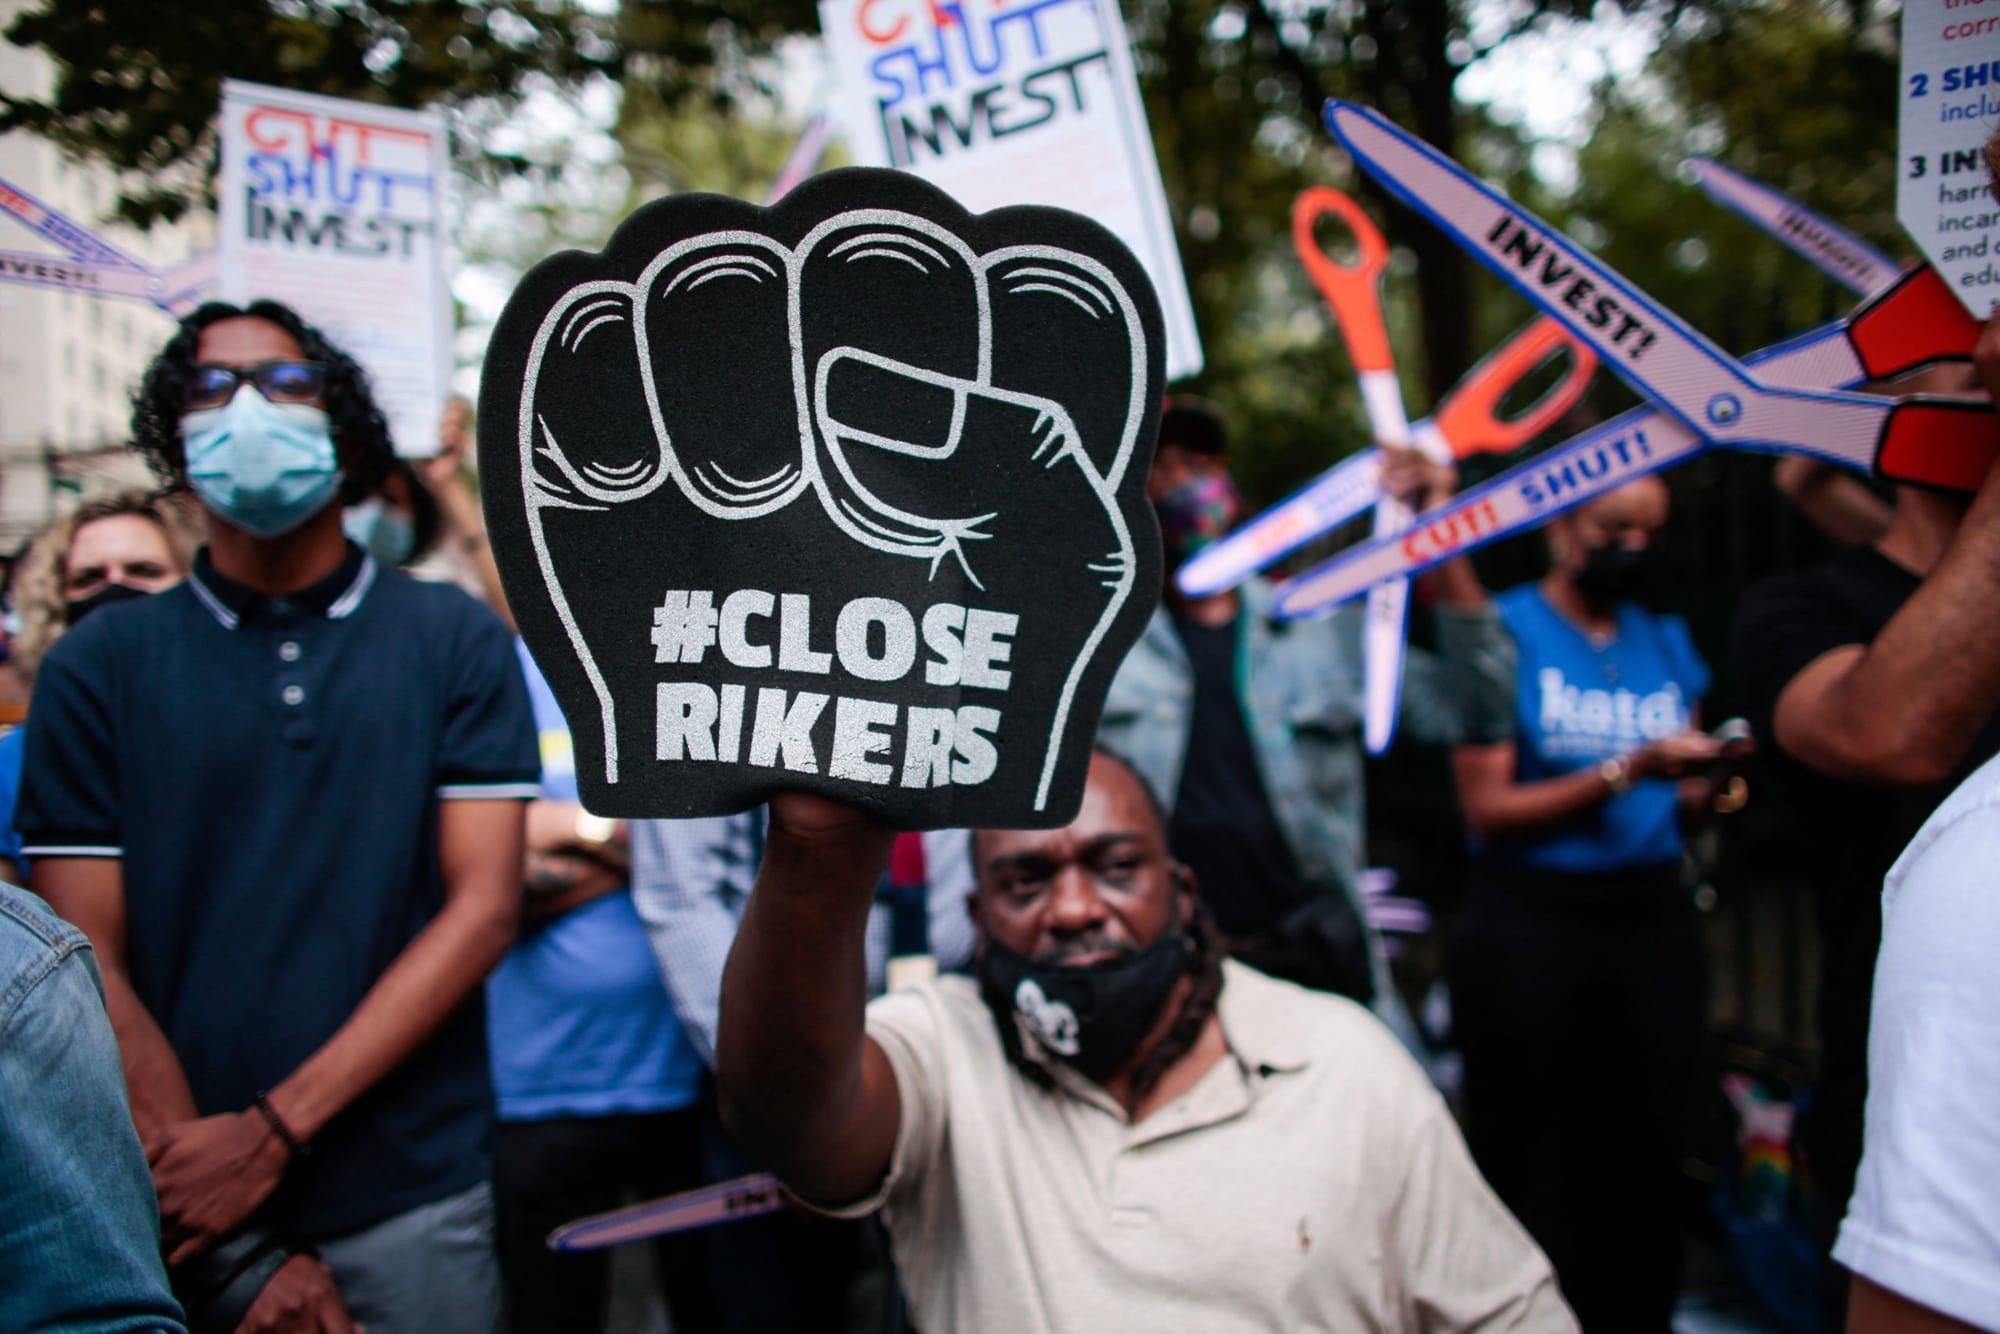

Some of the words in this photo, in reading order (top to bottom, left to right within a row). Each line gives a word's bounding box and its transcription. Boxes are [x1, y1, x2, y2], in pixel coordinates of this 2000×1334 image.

[877, 50, 1107, 168] INVEST
[1909, 73, 1928, 97] 2
[245, 104, 432, 166] CUT
[1909, 156, 1926, 178] 3
[1941, 149, 1986, 174] IN
[246, 151, 433, 208] SHUT
[246, 184, 433, 258] INVEST
[1943, 235, 1988, 261] and
[0, 256, 98, 286] VEST!
[1487, 216, 1658, 359] INVEST!
[1404, 501, 1498, 563] CUT!
[1521, 429, 1653, 506] SHUT!
[651, 589, 1019, 691] #CLOSE
[656, 682, 1001, 788] RIKERS
